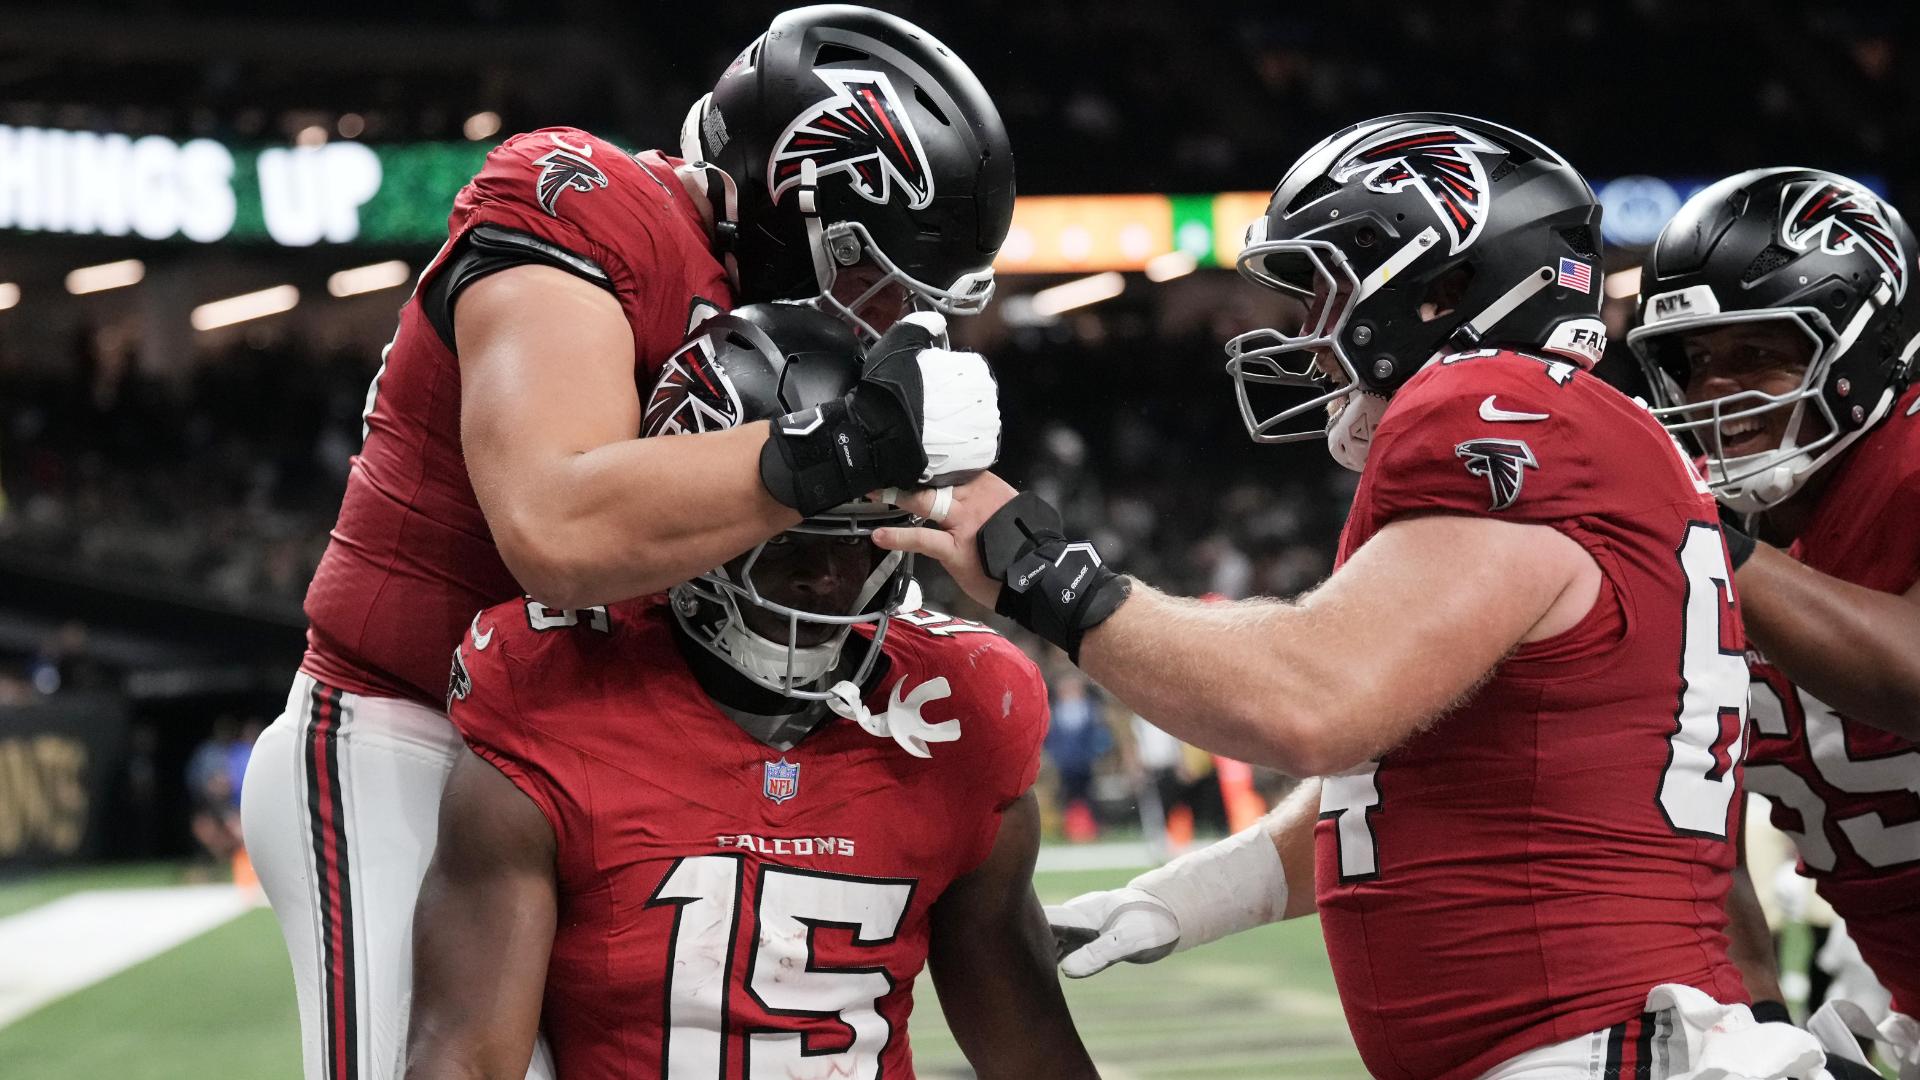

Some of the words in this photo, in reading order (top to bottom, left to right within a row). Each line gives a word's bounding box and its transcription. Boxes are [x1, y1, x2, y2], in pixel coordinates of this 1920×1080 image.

[257, 142, 383, 247] UP
[1656, 293, 1691, 315] ATL
[769, 778, 793, 796] NFL
[714, 834, 855, 857] FALCONS
[642, 853, 920, 1080] 15
